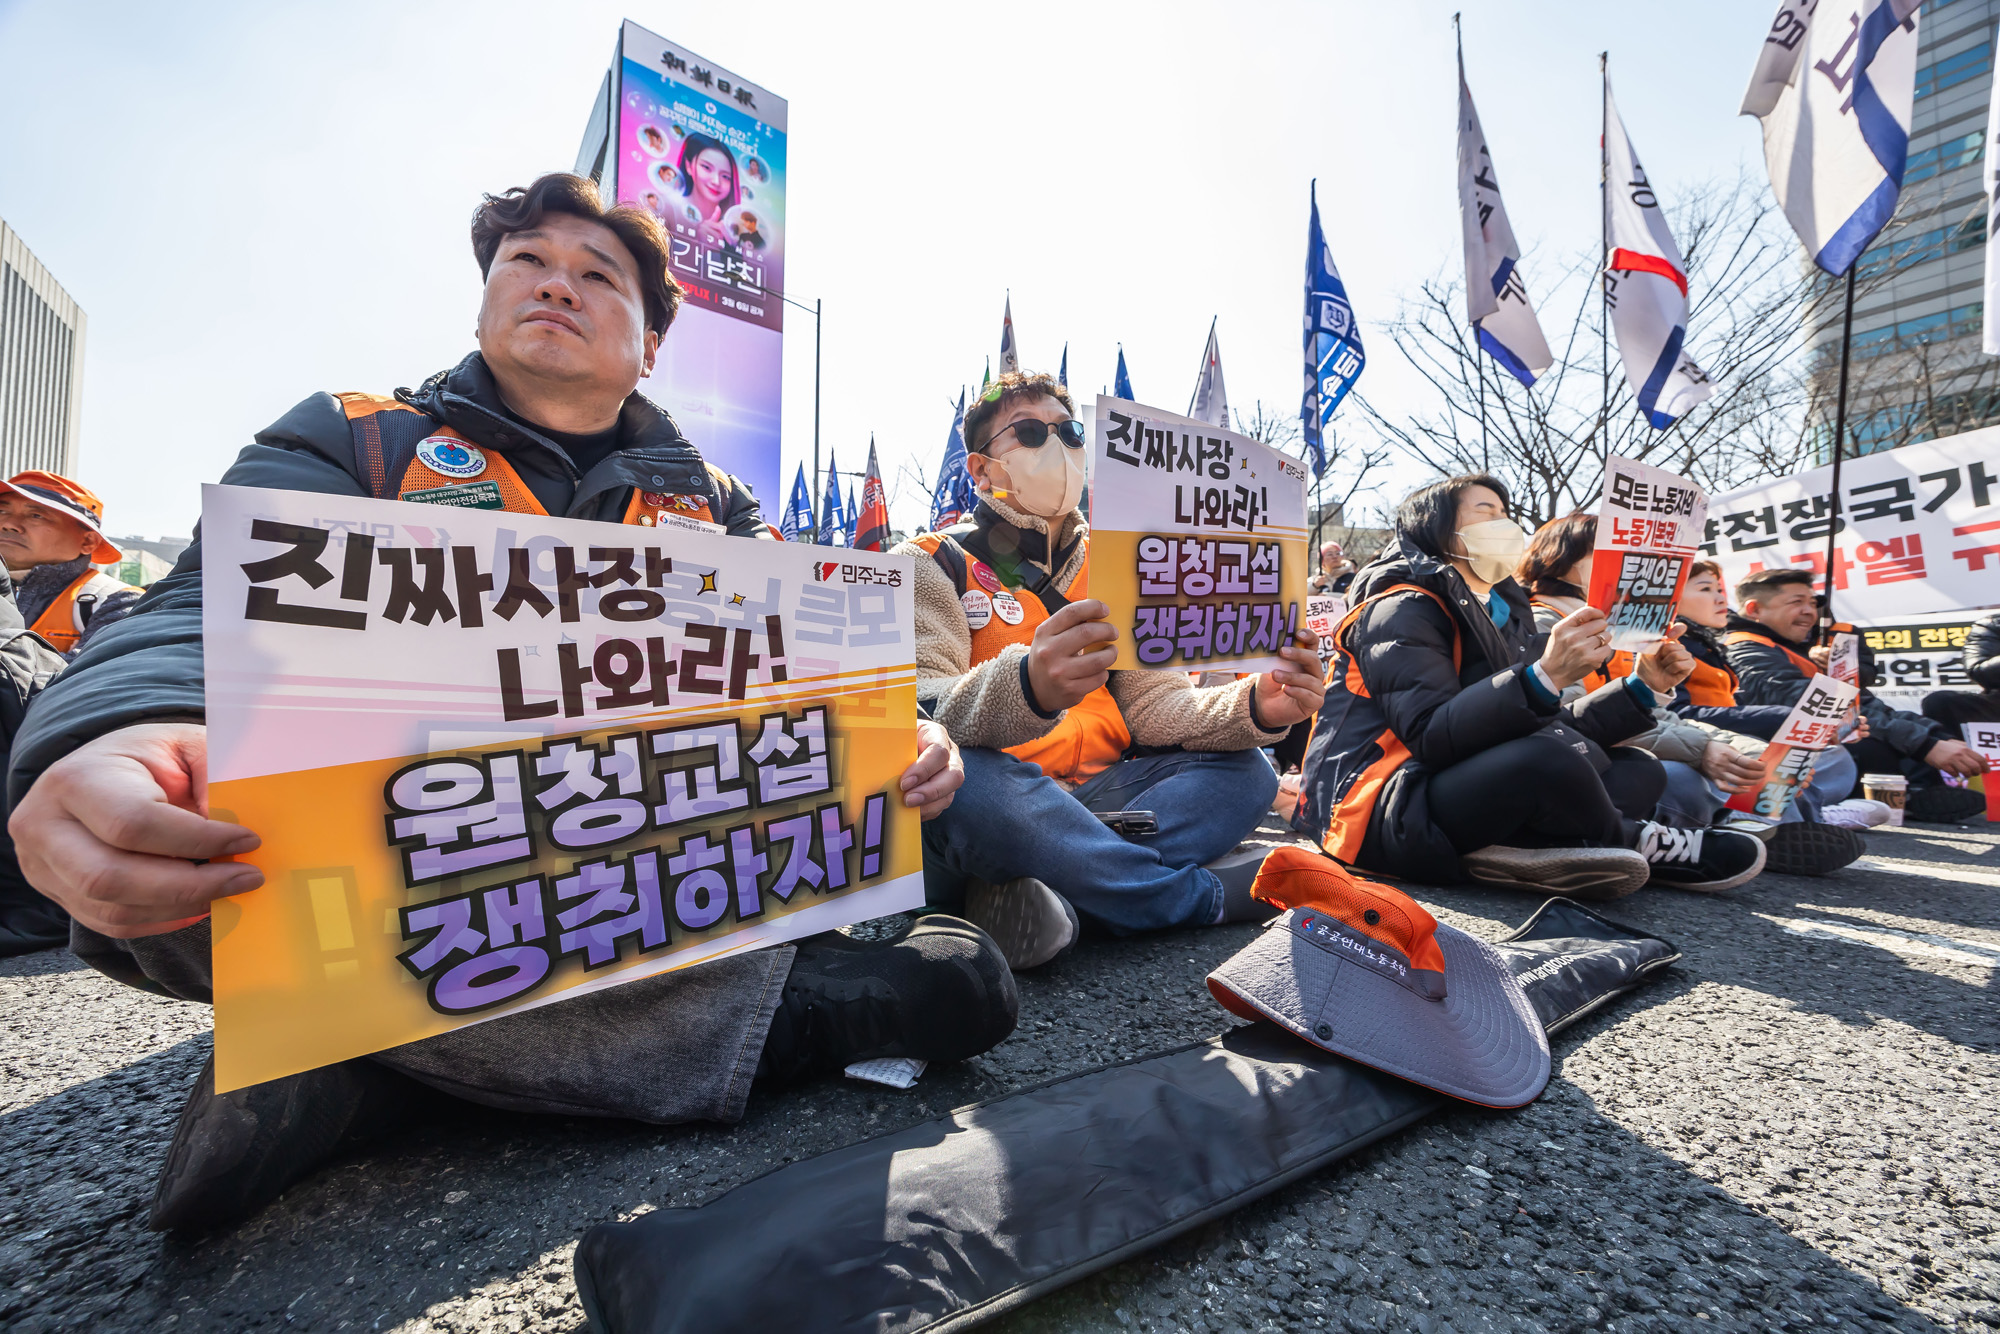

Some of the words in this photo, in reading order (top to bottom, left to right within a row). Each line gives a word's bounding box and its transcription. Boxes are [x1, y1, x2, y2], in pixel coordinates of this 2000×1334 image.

[660, 50, 758, 110] 朝鮮日報
[677, 279, 711, 301] TFLIX
[1106, 411, 1234, 480] 진짜사장
[1286, 463, 1306, 482] 민주노총
[1175, 484, 1268, 532] 나와라!
[1609, 472, 1648, 511] 모든
[1650, 484, 1697, 517] 노동자의
[1612, 517, 1676, 548] 노동기본권
[241, 519, 672, 631] 진짜사장
[842, 562, 901, 589] 민주노총
[1136, 535, 1281, 599] 원청교섭
[1616, 553, 1683, 598] 투쟁으로
[1133, 602, 1296, 666] 쟁취하자!
[497, 615, 788, 721] 나와라!
[385, 706, 832, 886] 원청교섭
[397, 792, 889, 1015] 쟁취하자!
[1317, 924, 1406, 977] 공공연대노동조합
